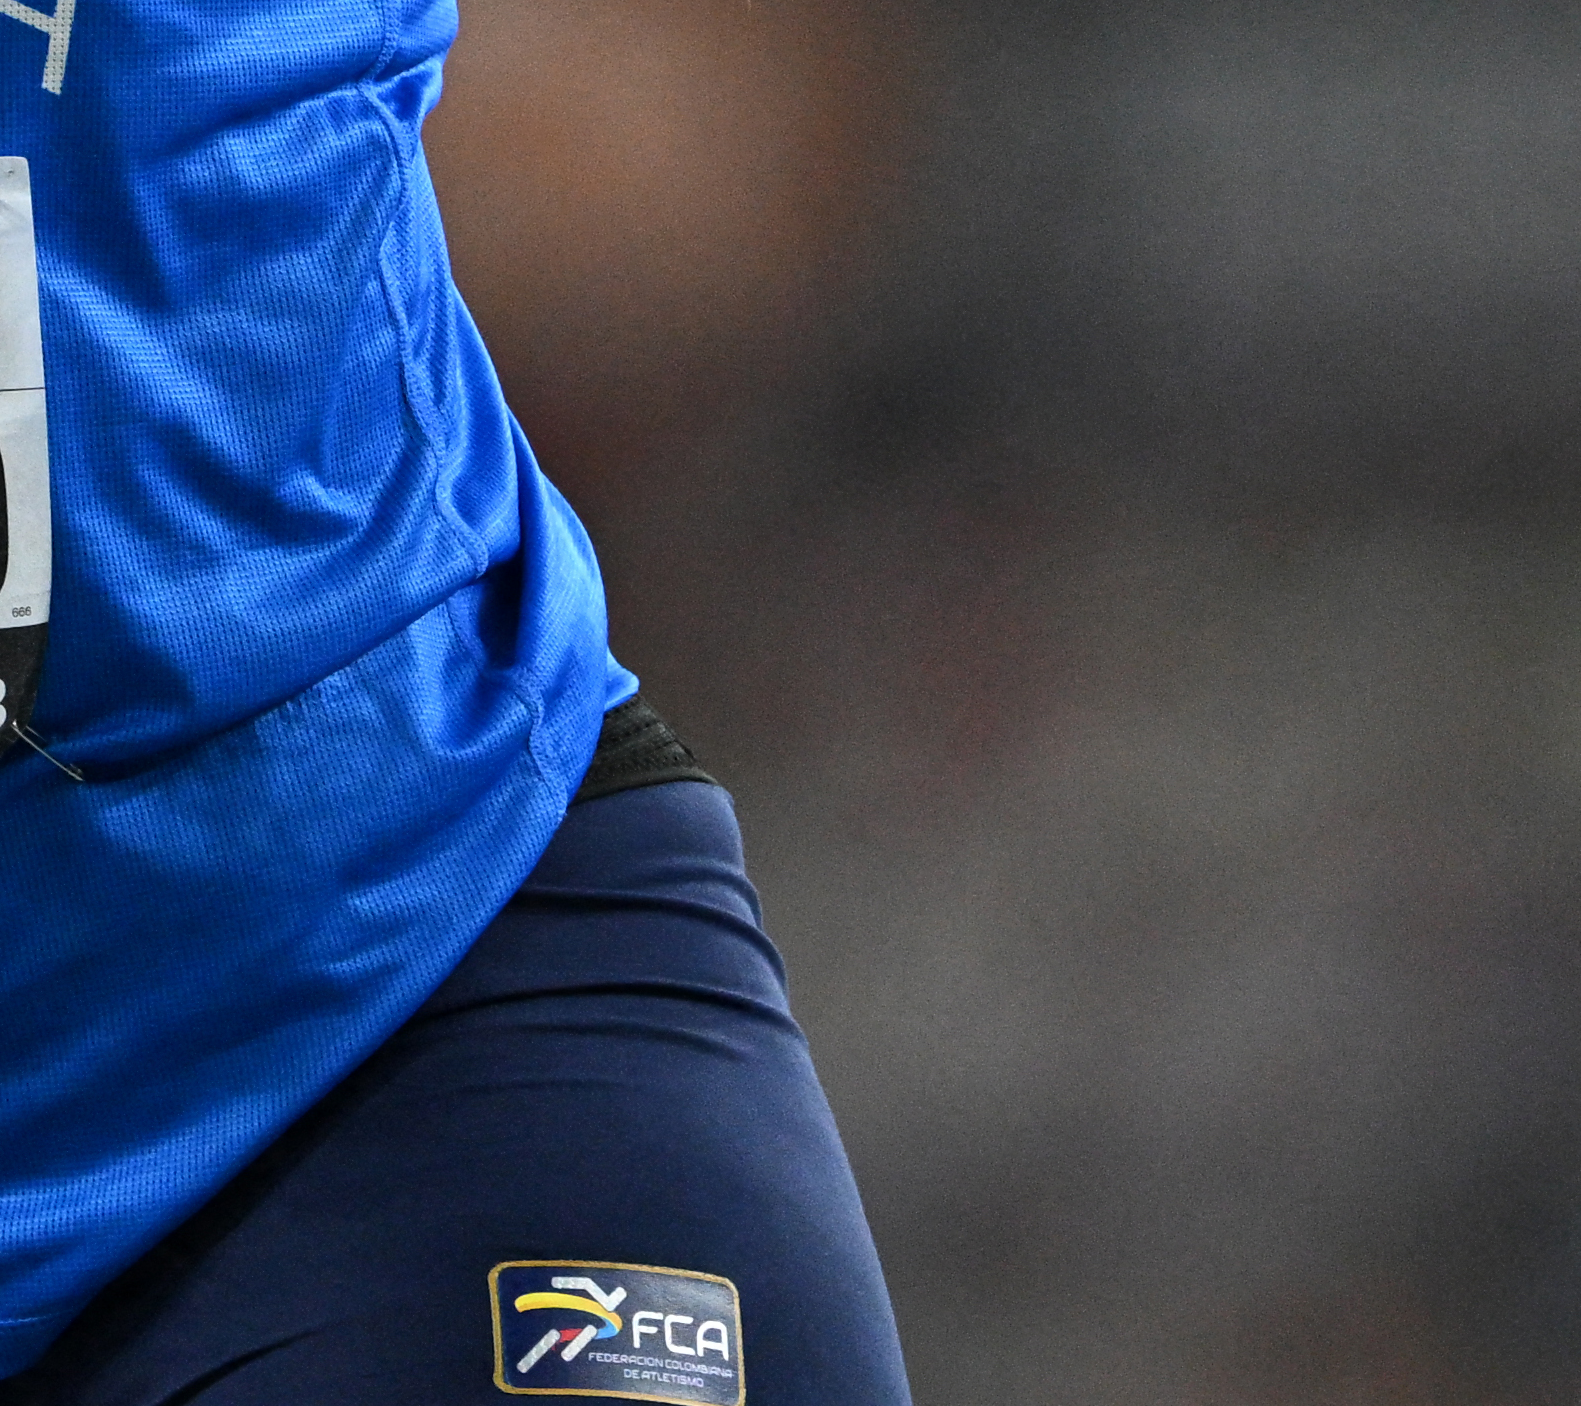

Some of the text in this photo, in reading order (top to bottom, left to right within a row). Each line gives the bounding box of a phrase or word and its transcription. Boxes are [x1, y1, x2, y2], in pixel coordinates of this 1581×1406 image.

[11, 606, 32, 618] 666
[632, 1310, 730, 1361] FCA
[623, 1369, 704, 1388] DE ATLETISMO
[665, 1360, 734, 1379] COLOMBIANA
